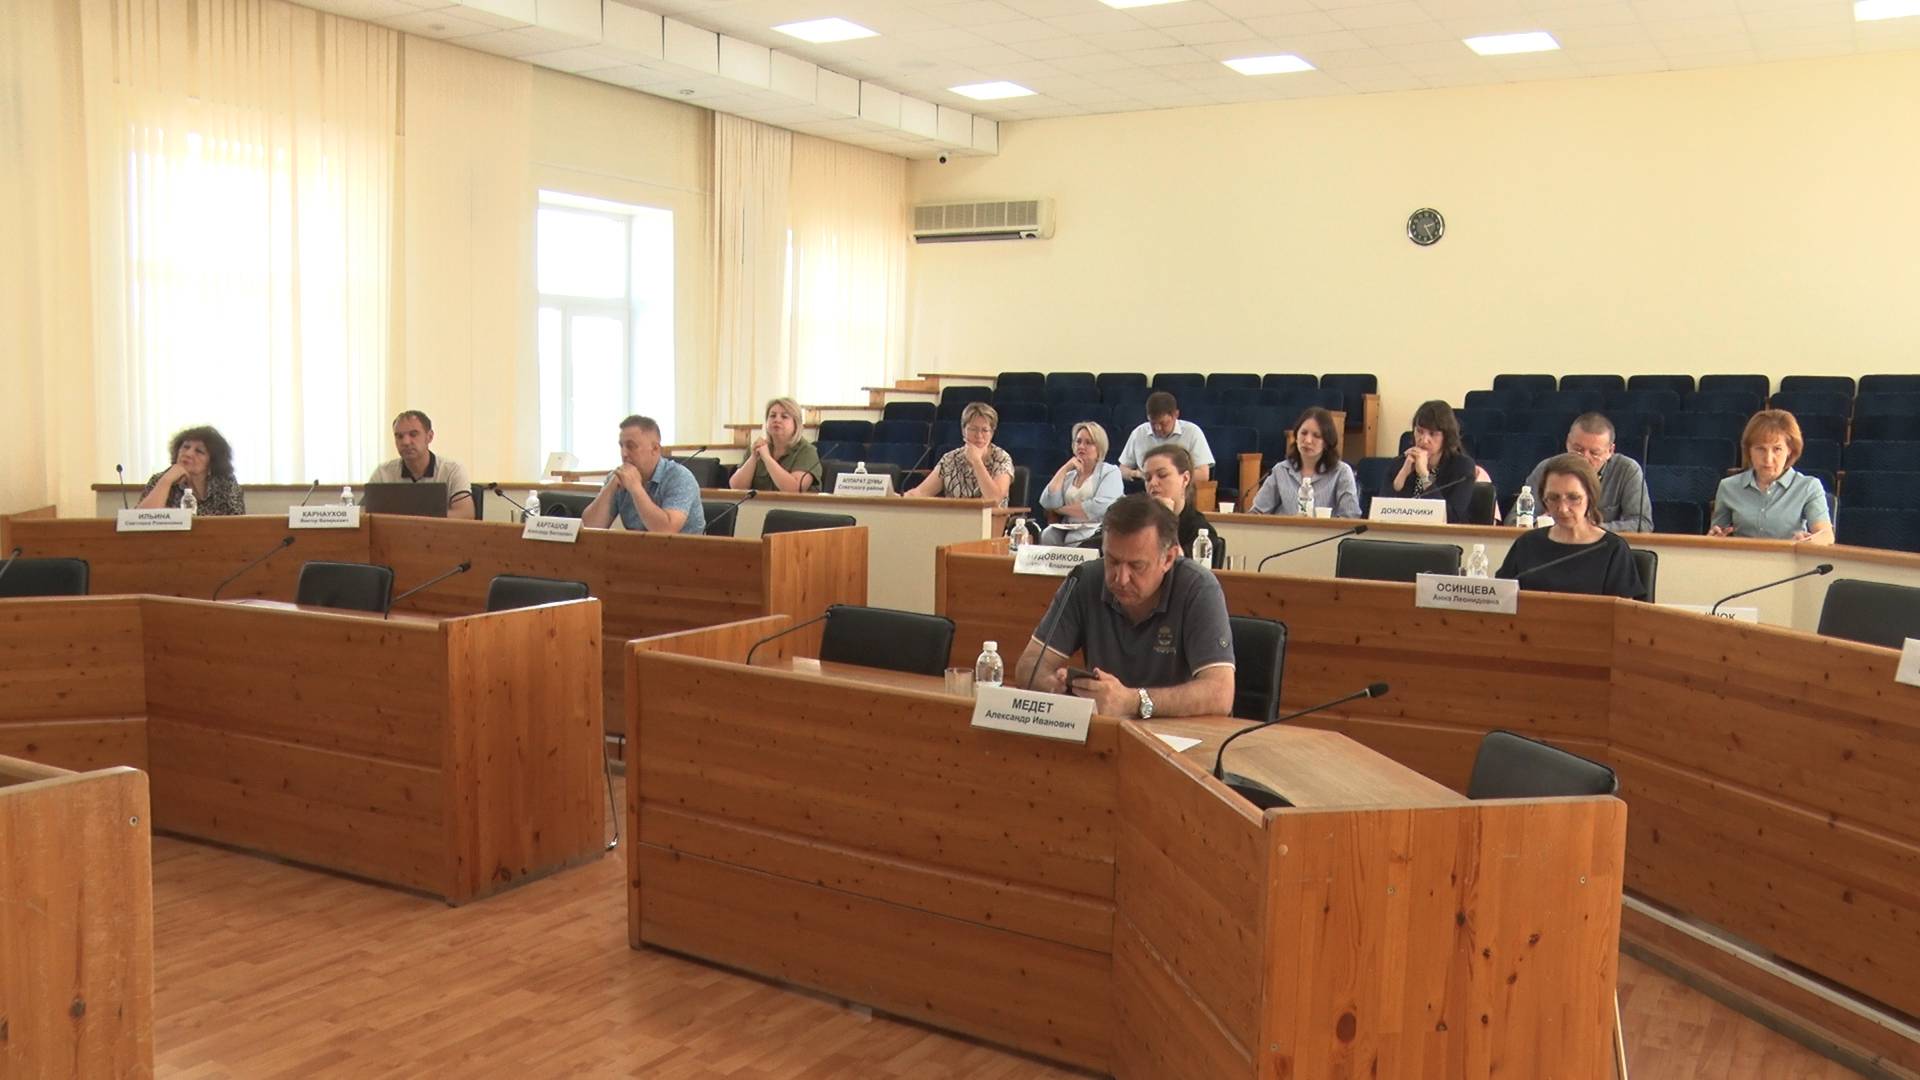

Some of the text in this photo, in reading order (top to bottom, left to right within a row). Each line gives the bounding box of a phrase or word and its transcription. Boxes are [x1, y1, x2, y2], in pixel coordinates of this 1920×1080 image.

[1380, 507, 1434, 516] ДОКЛАДЧИКИ
[536, 521, 569, 530] КАРТАШОВ
[1436, 583, 1497, 596] ОСИНЦЕВА
[1011, 698, 1054, 714] МЕДЕТ
[985, 709, 1076, 730] Александр Иванович
